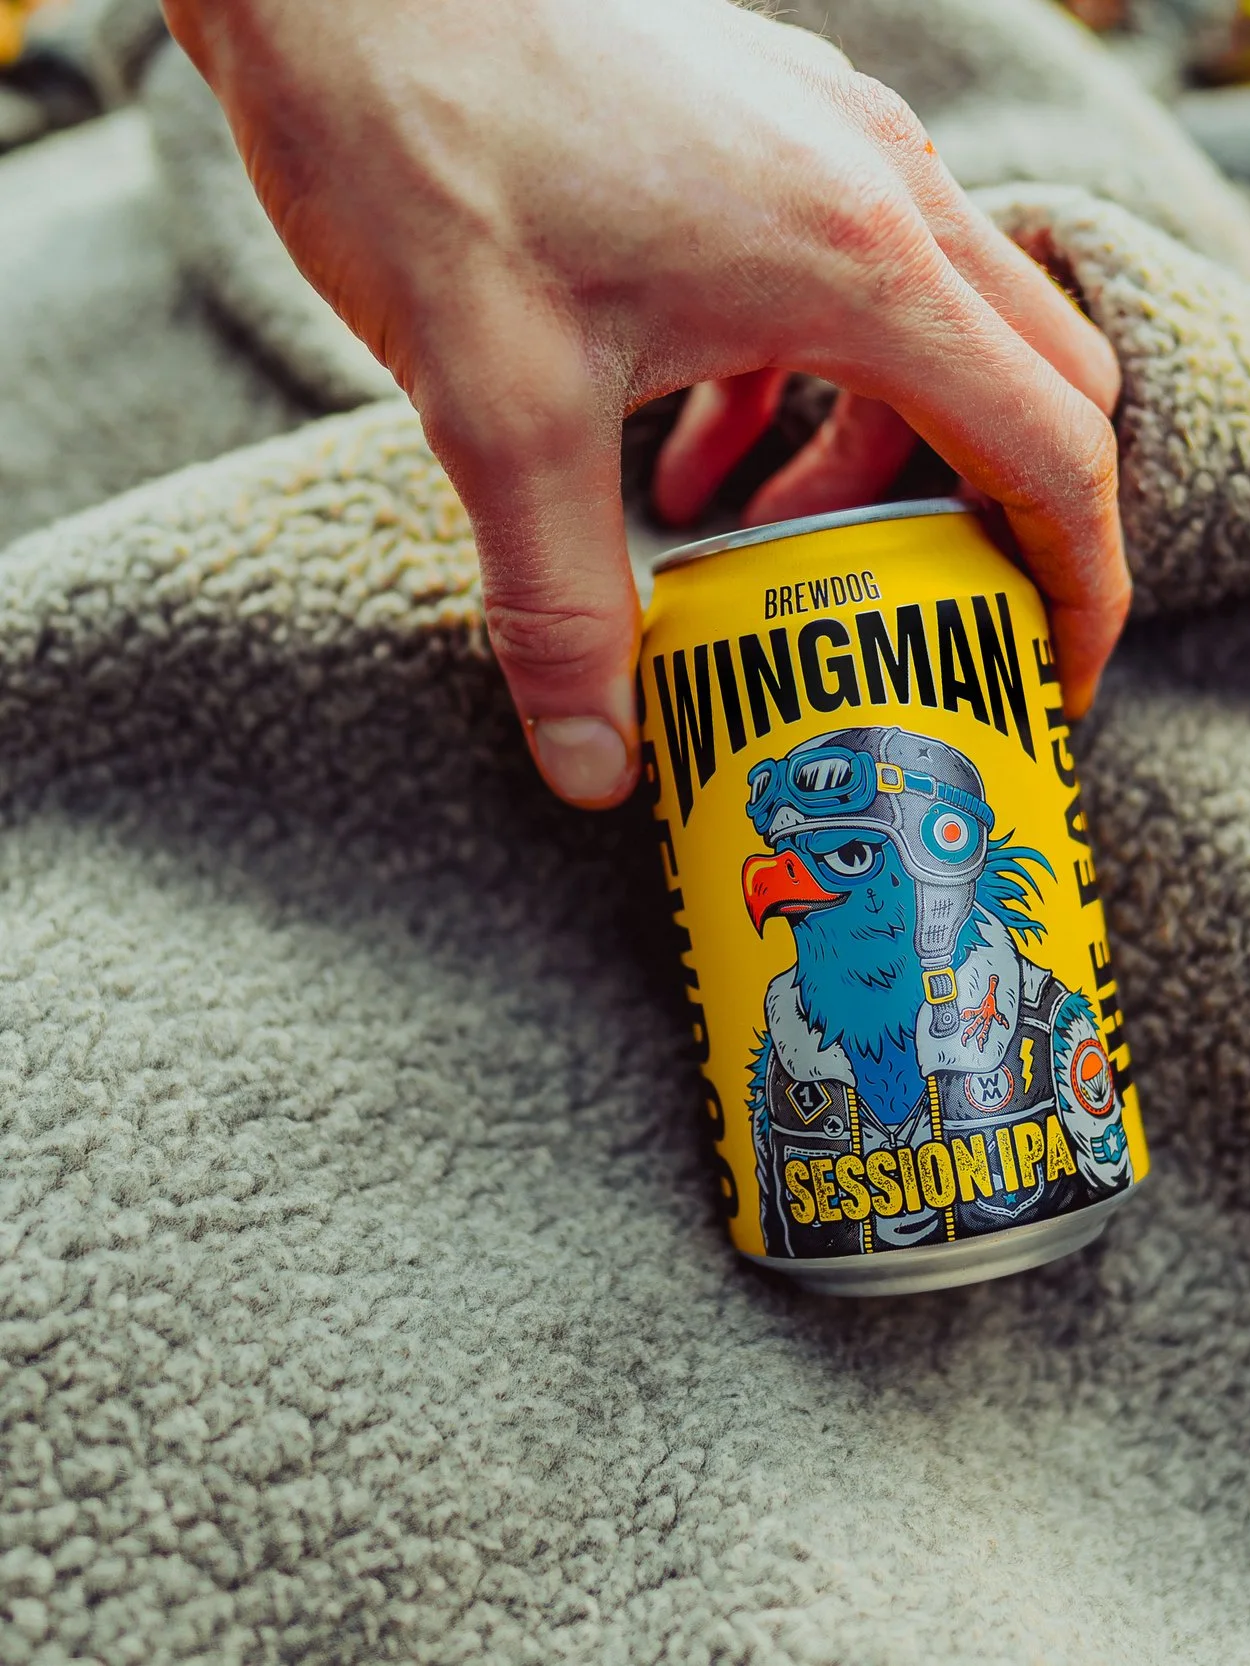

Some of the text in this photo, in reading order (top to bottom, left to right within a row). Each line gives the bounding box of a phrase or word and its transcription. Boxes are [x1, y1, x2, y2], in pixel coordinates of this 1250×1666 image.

[764, 570, 881, 620] BREWDOG
[653, 591, 1038, 829] WINGMAN
[799, 1086, 814, 1107] 1
[784, 1114, 1078, 1225] SESSION IPA
